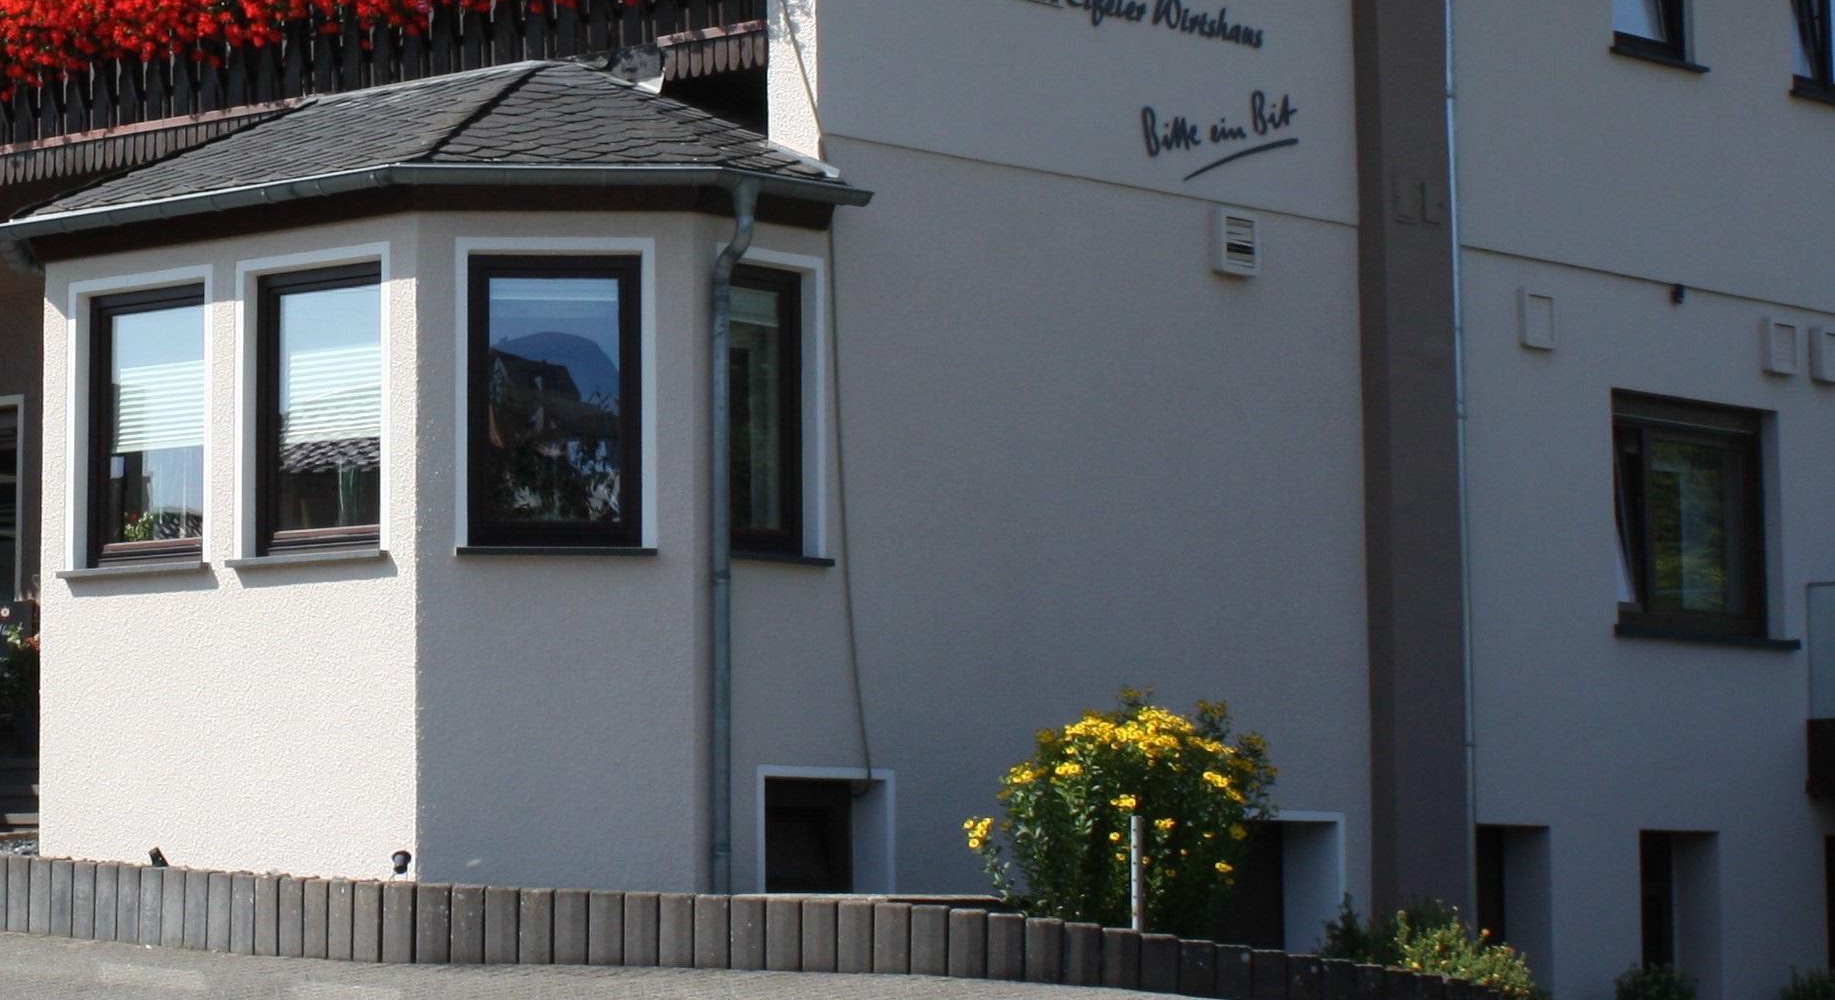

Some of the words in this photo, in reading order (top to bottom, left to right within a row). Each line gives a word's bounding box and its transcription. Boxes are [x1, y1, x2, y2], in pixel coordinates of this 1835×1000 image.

[1142, 105, 1202, 157] Bitte
[1210, 118, 1247, 142] ein
[1251, 90, 1297, 135] Bit
